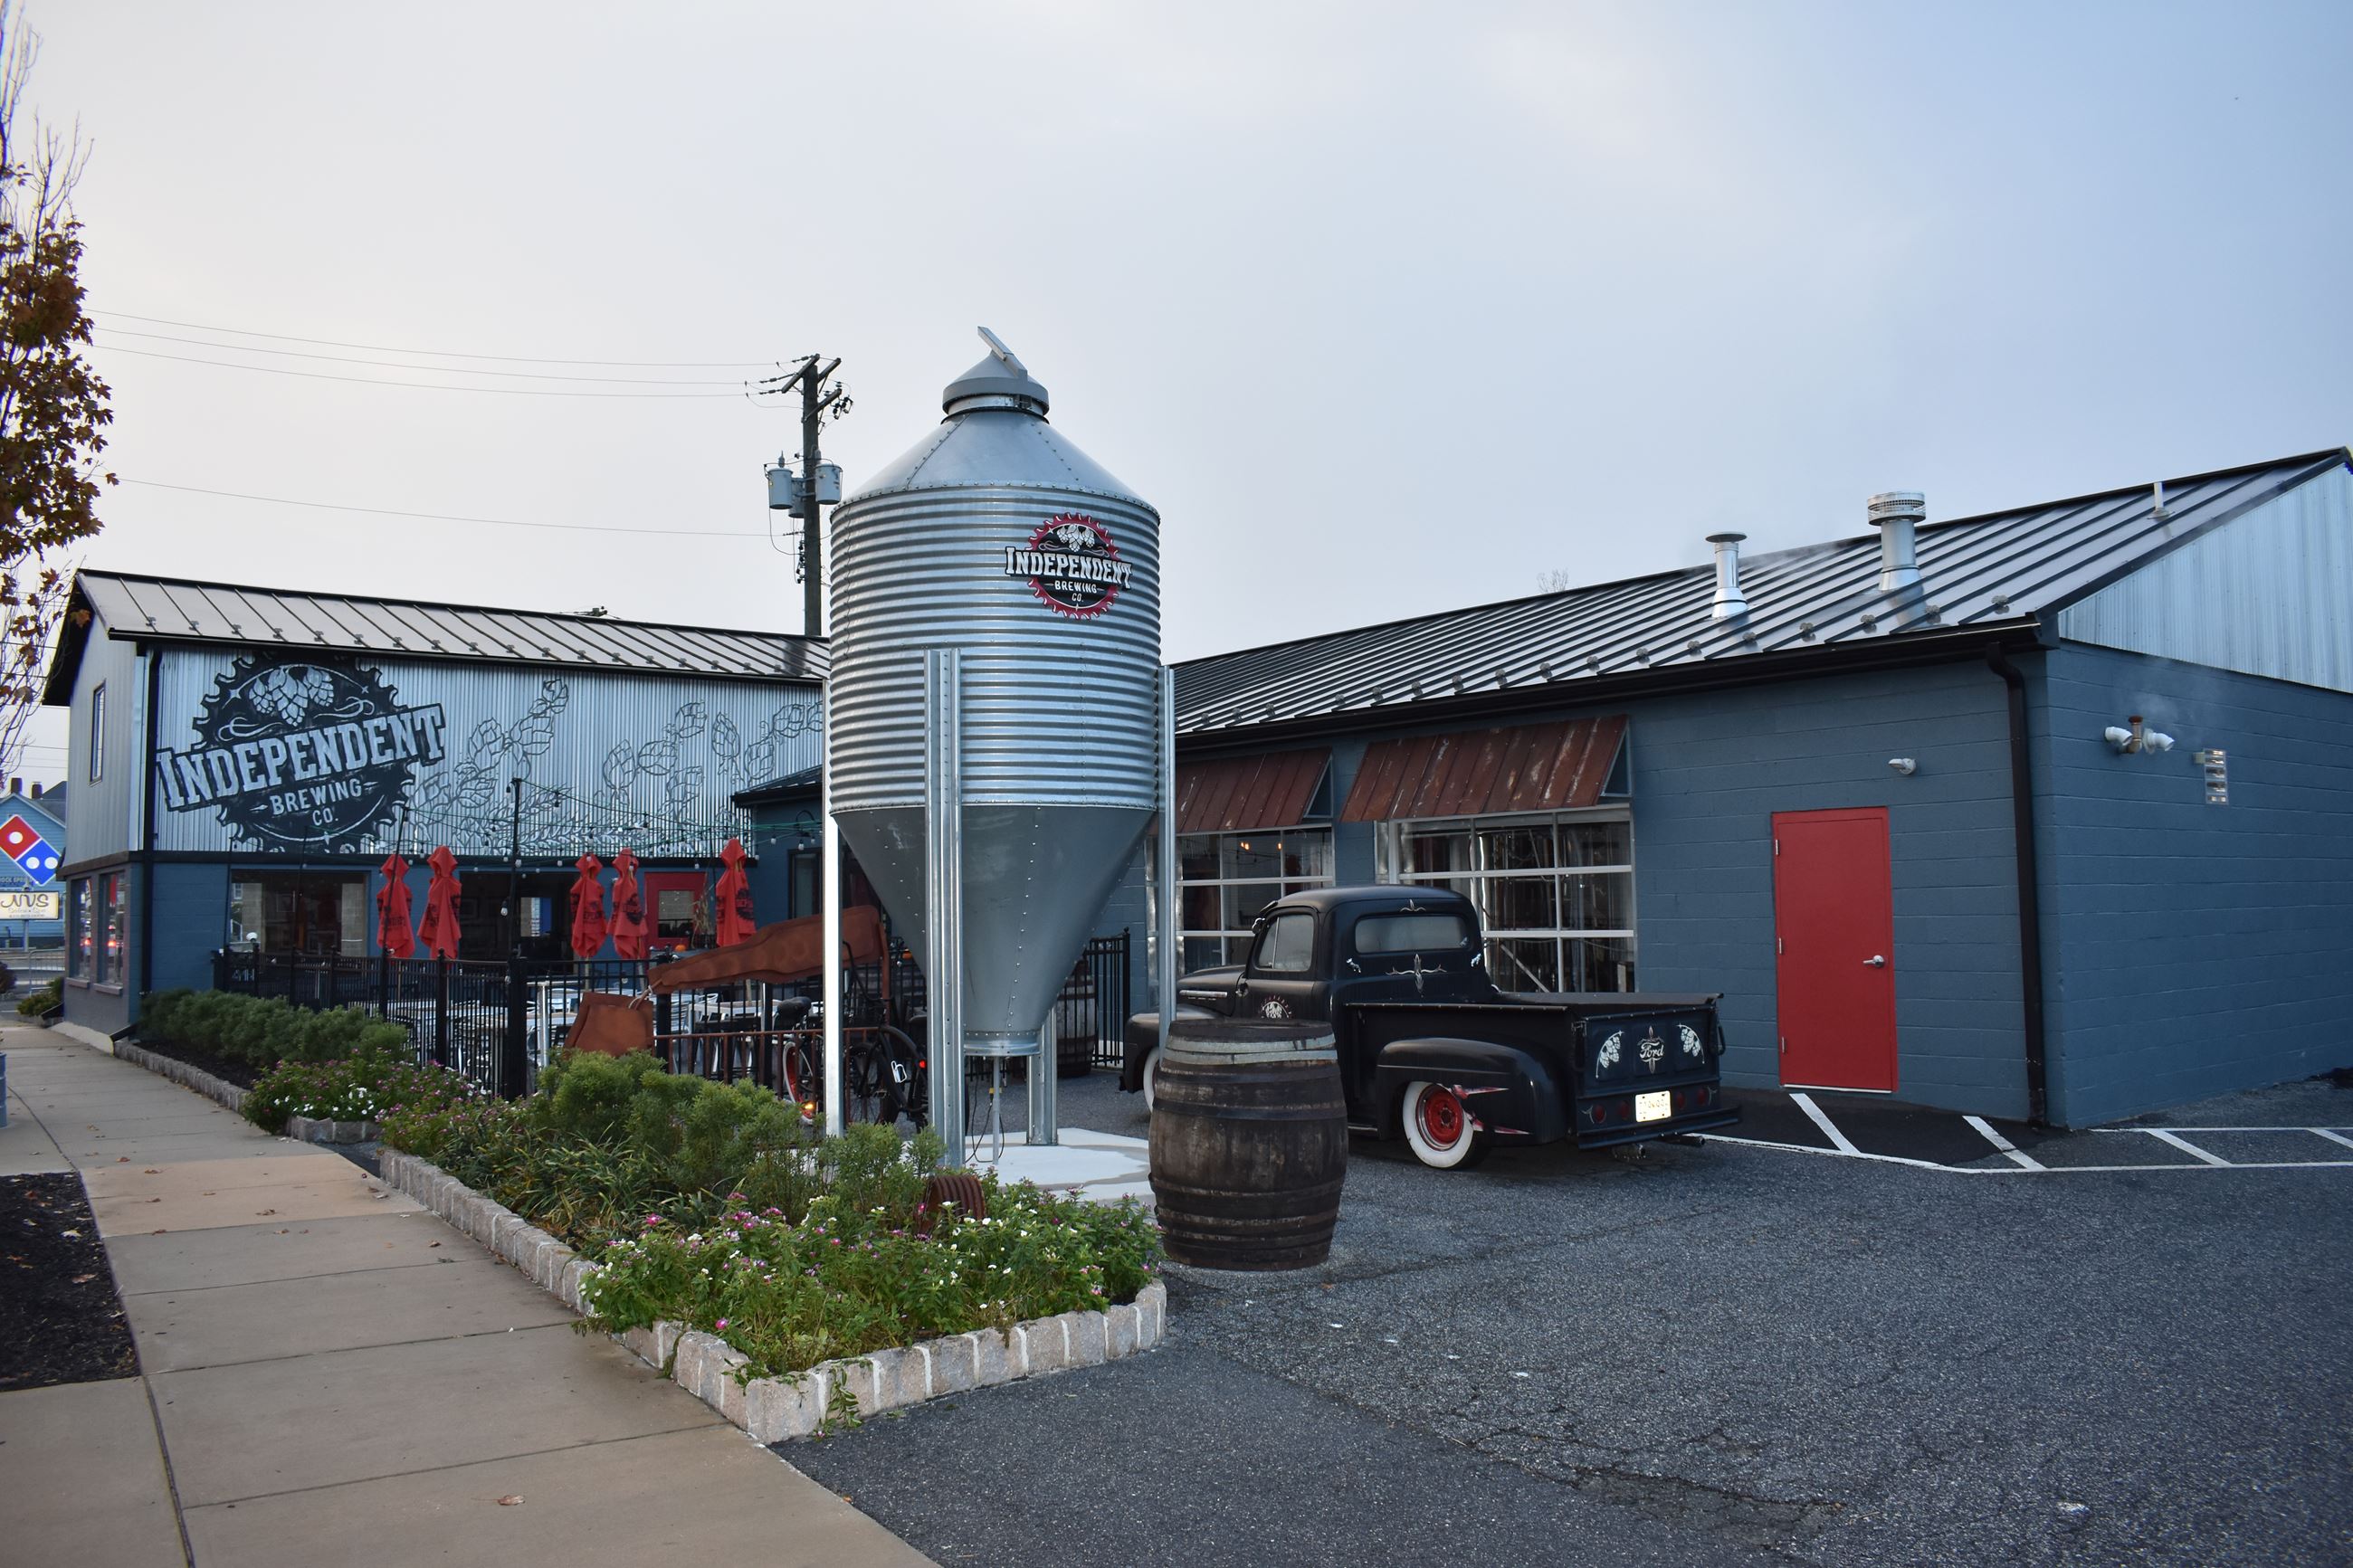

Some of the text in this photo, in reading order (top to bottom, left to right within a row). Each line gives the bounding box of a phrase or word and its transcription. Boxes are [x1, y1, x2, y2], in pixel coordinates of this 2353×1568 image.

[1006, 546, 1131, 588] INDEPENDENT
[1054, 580, 1097, 594] BREWING
[1072, 593, 1083, 602] CO.
[156, 705, 444, 809] INDEPENDENT
[270, 777, 362, 815] BREWING
[312, 809, 338, 826] CO.
[1639, 1041, 1664, 1059] Ford
